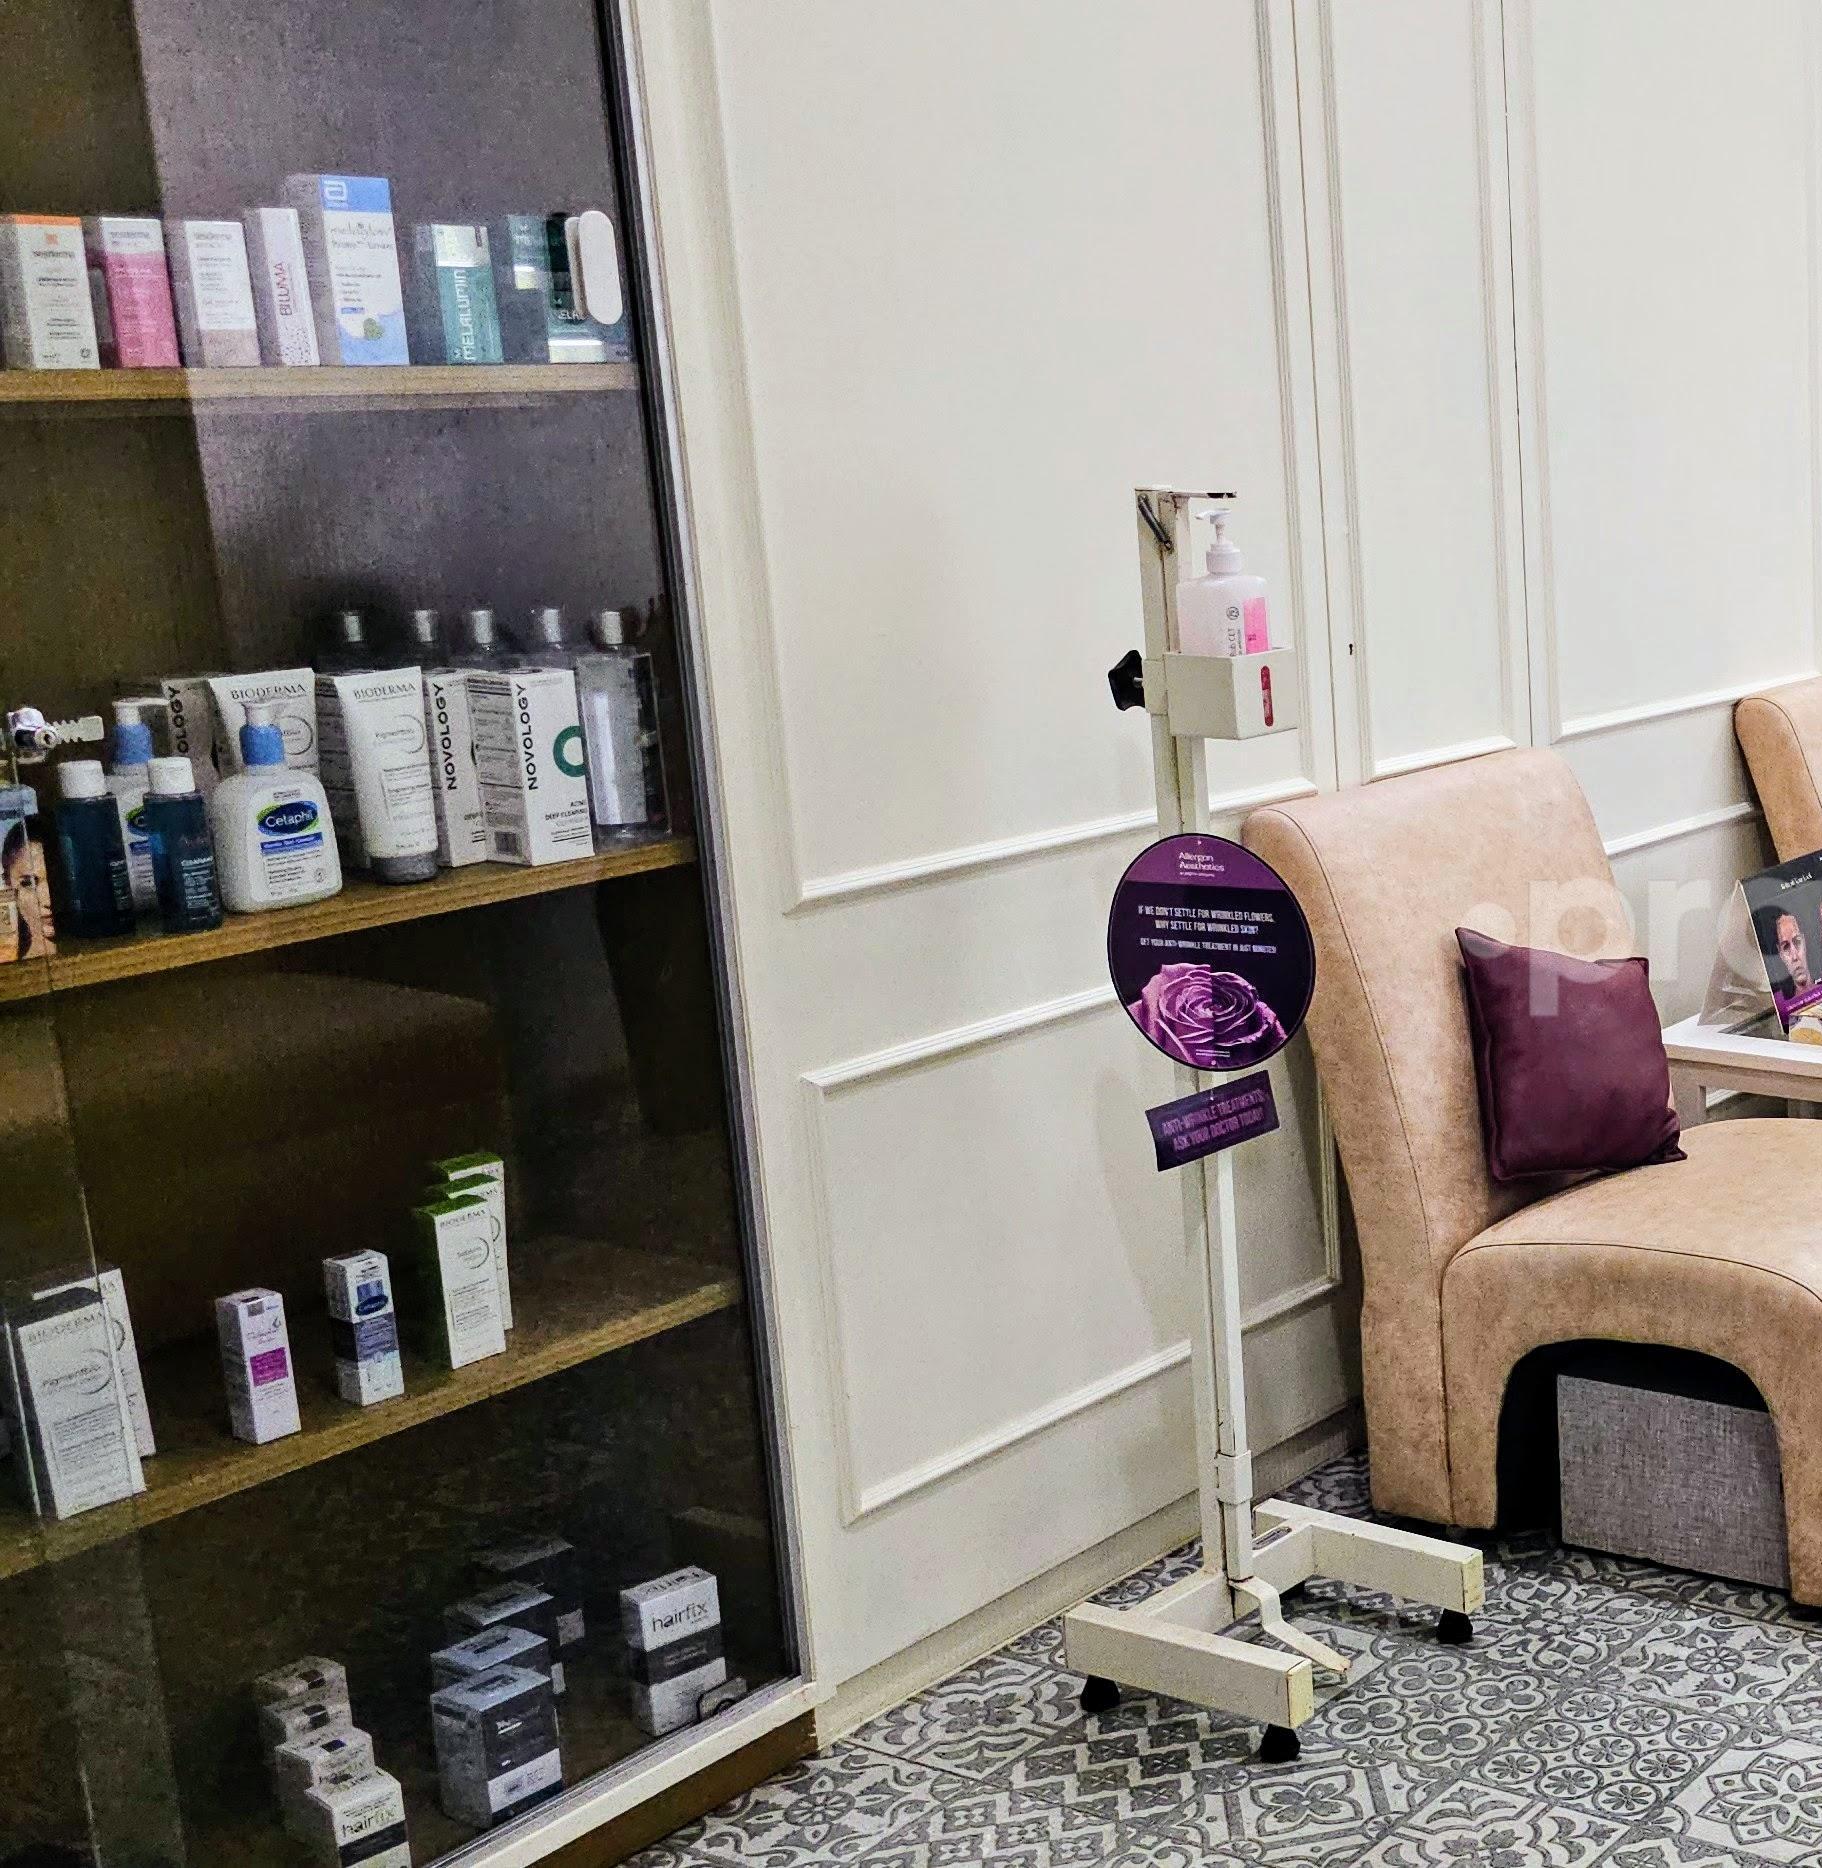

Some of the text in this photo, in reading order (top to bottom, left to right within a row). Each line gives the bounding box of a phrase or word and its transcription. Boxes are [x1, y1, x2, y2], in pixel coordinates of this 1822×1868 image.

[273, 261, 293, 316] BILUMA
[230, 682, 307, 700] BIODERMA
[353, 682, 416, 700] BIODERMA
[433, 682, 458, 790] NOVOLOGY
[516, 684, 539, 790] NOVOLOGY
[264, 808, 314, 829] Cetaphil
[1179, 852, 1214, 862] Allergan
[1180, 861, 1225, 871] Aesthetics
[1174, 908, 1196, 918] SETTLE
[1197, 908, 1210, 918] FOR
[1211, 909, 1243, 920] WRINKLED
[1170, 920, 1192, 931] SETTLE
[1193, 921, 1206, 932] FOR
[1207, 922, 1239, 933] WRINKLED
[652, 1602, 708, 1632] hairfix
[342, 1809, 395, 1838] hairfix
